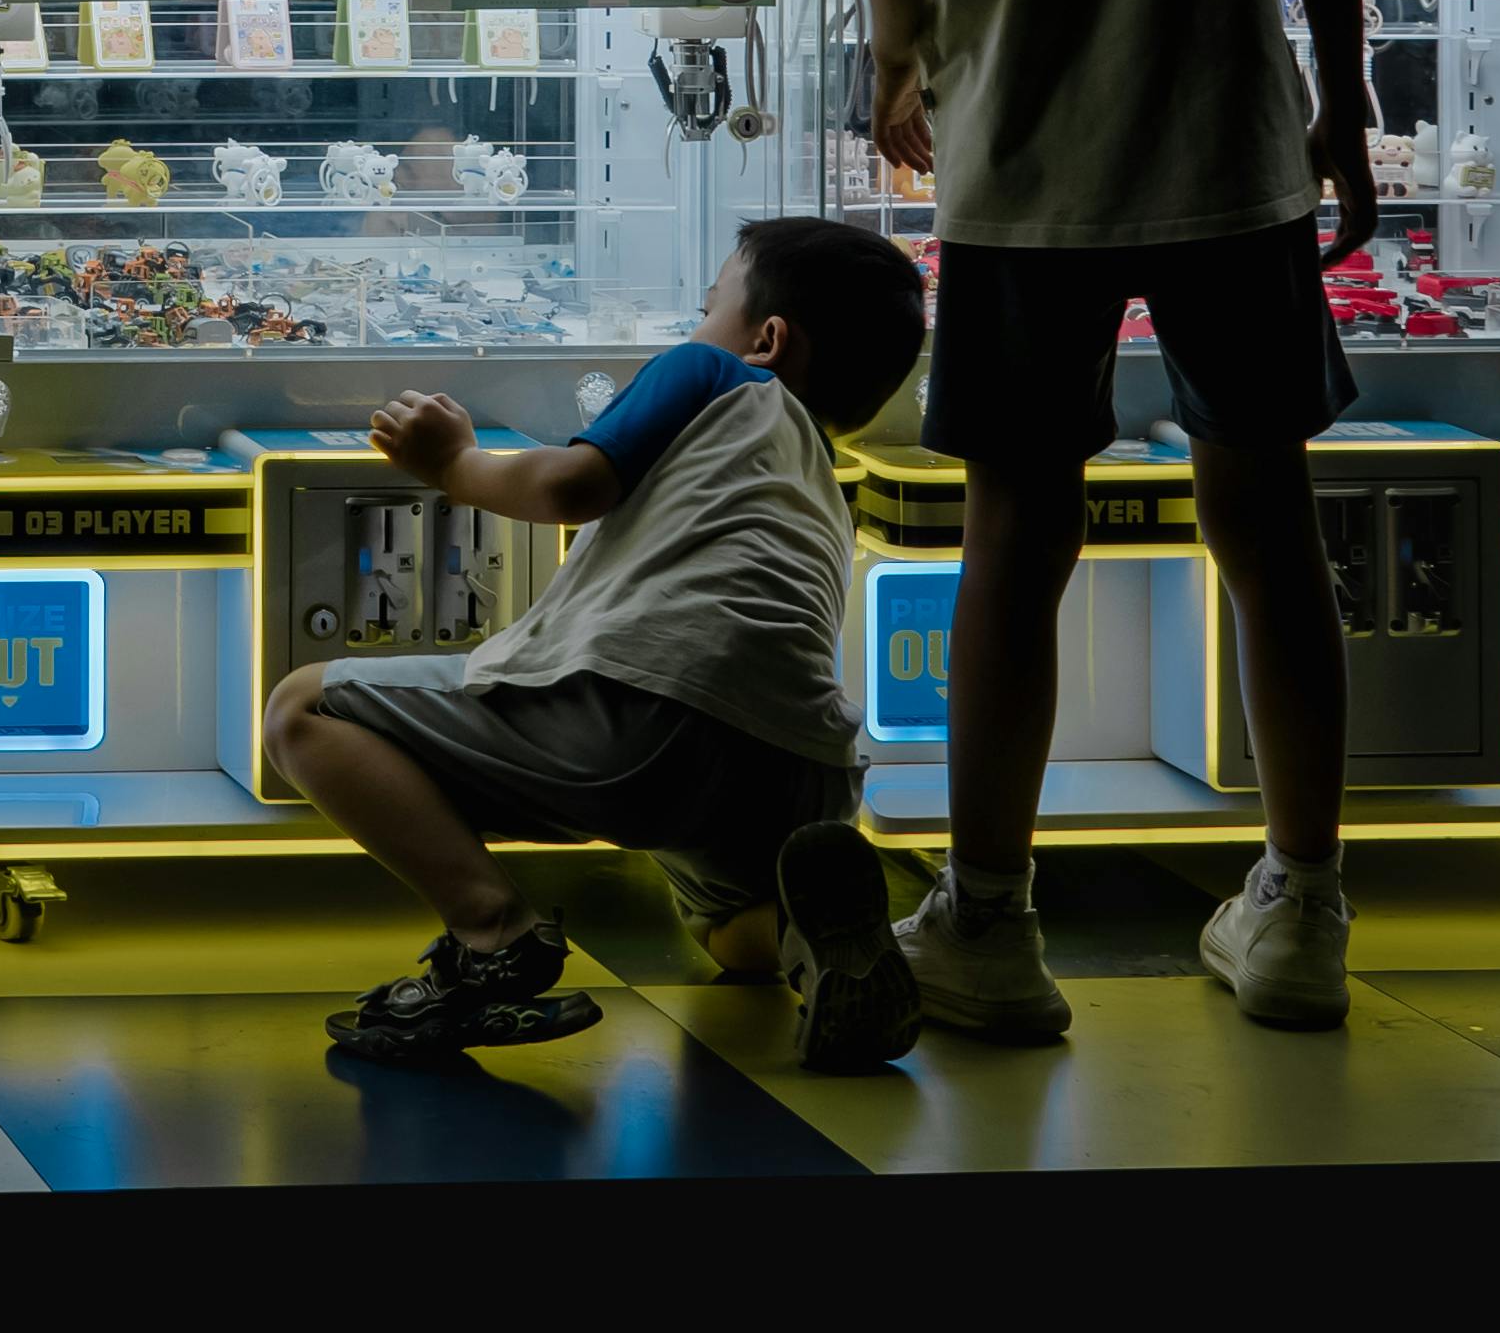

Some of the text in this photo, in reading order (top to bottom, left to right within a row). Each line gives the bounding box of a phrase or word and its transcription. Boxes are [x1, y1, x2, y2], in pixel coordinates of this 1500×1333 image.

[24, 508, 191, 535] 03 PLAYER
[1086, 499, 1145, 525] YER
[888, 629, 950, 681] OU
